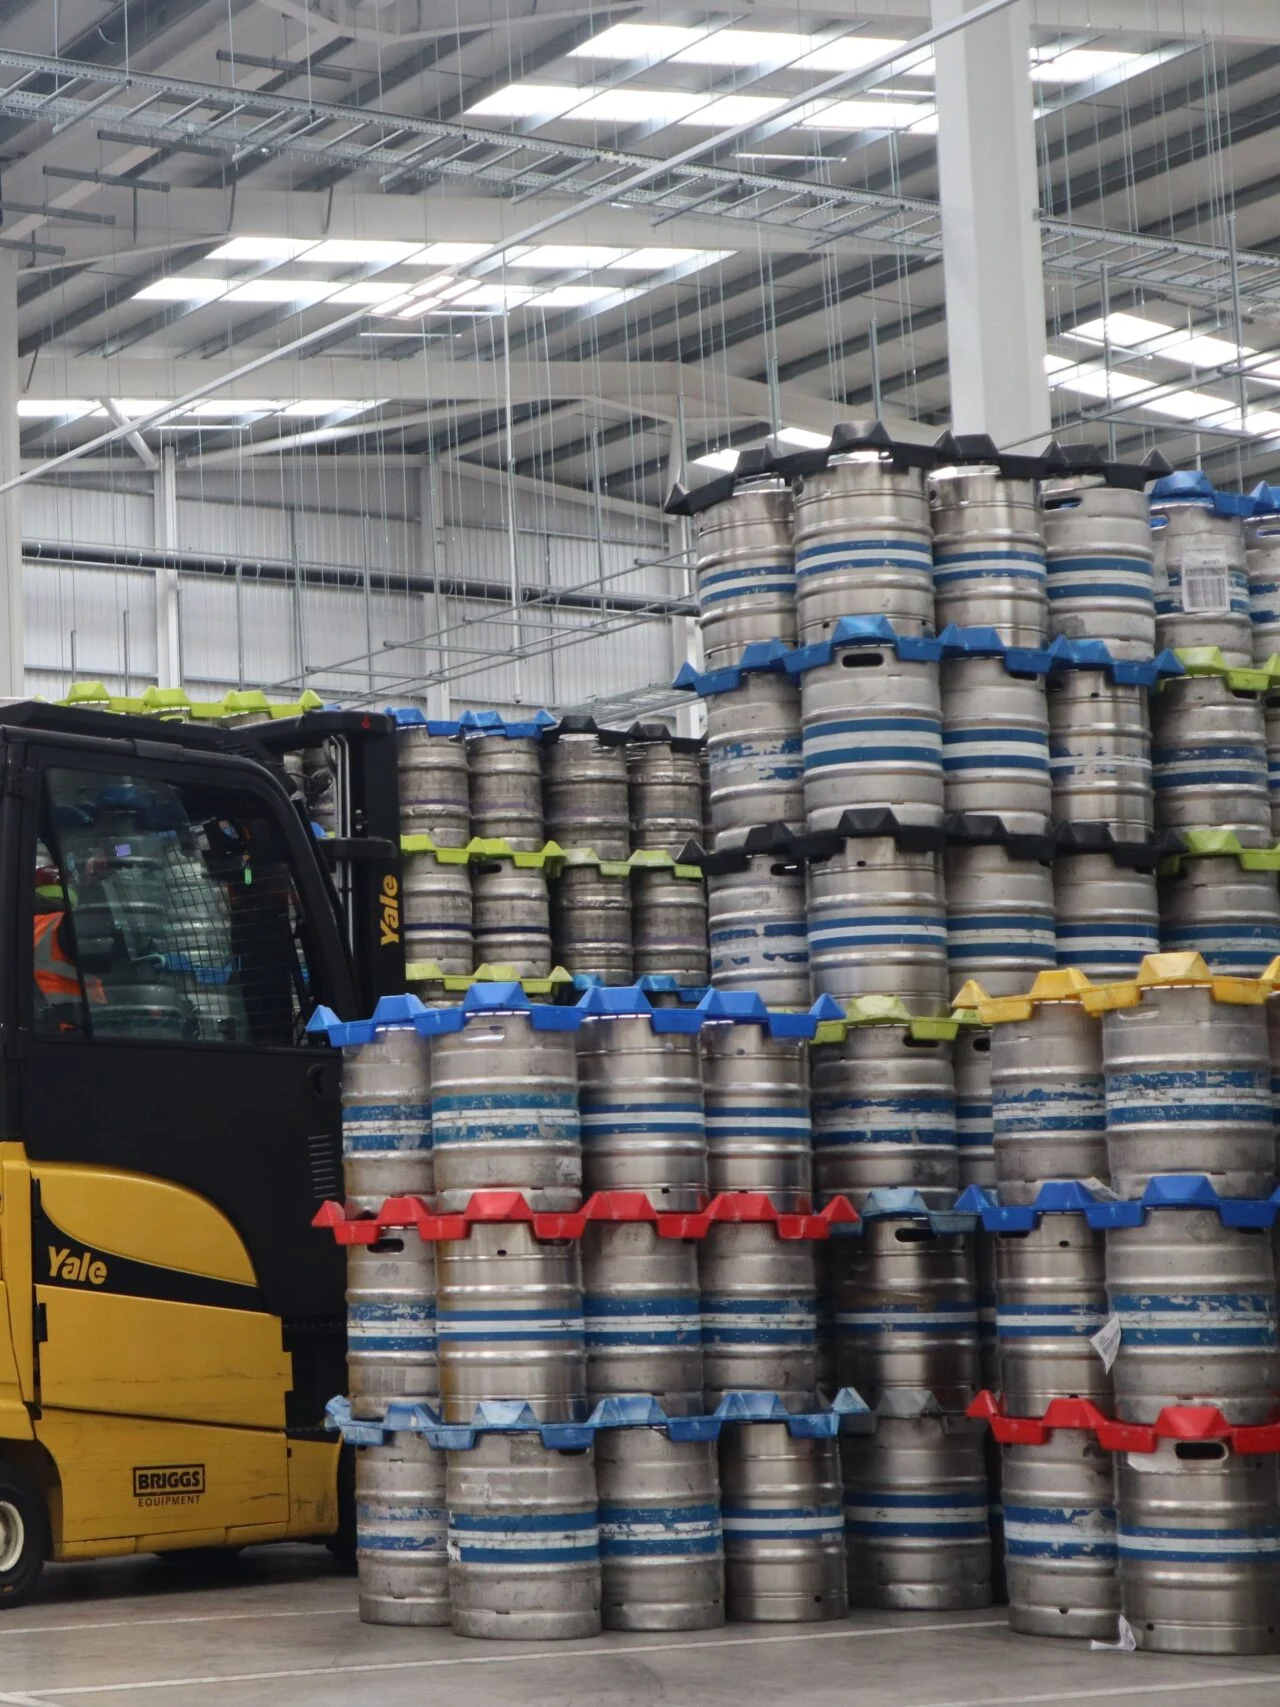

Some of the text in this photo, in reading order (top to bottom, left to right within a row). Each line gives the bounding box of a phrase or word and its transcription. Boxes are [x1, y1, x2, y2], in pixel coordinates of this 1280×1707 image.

[379, 874, 399, 945] Yale
[48, 1246, 107, 1285] Yale
[138, 1471, 200, 1490] BRIGGS
[138, 1495, 200, 1507] EQUIPMENT
